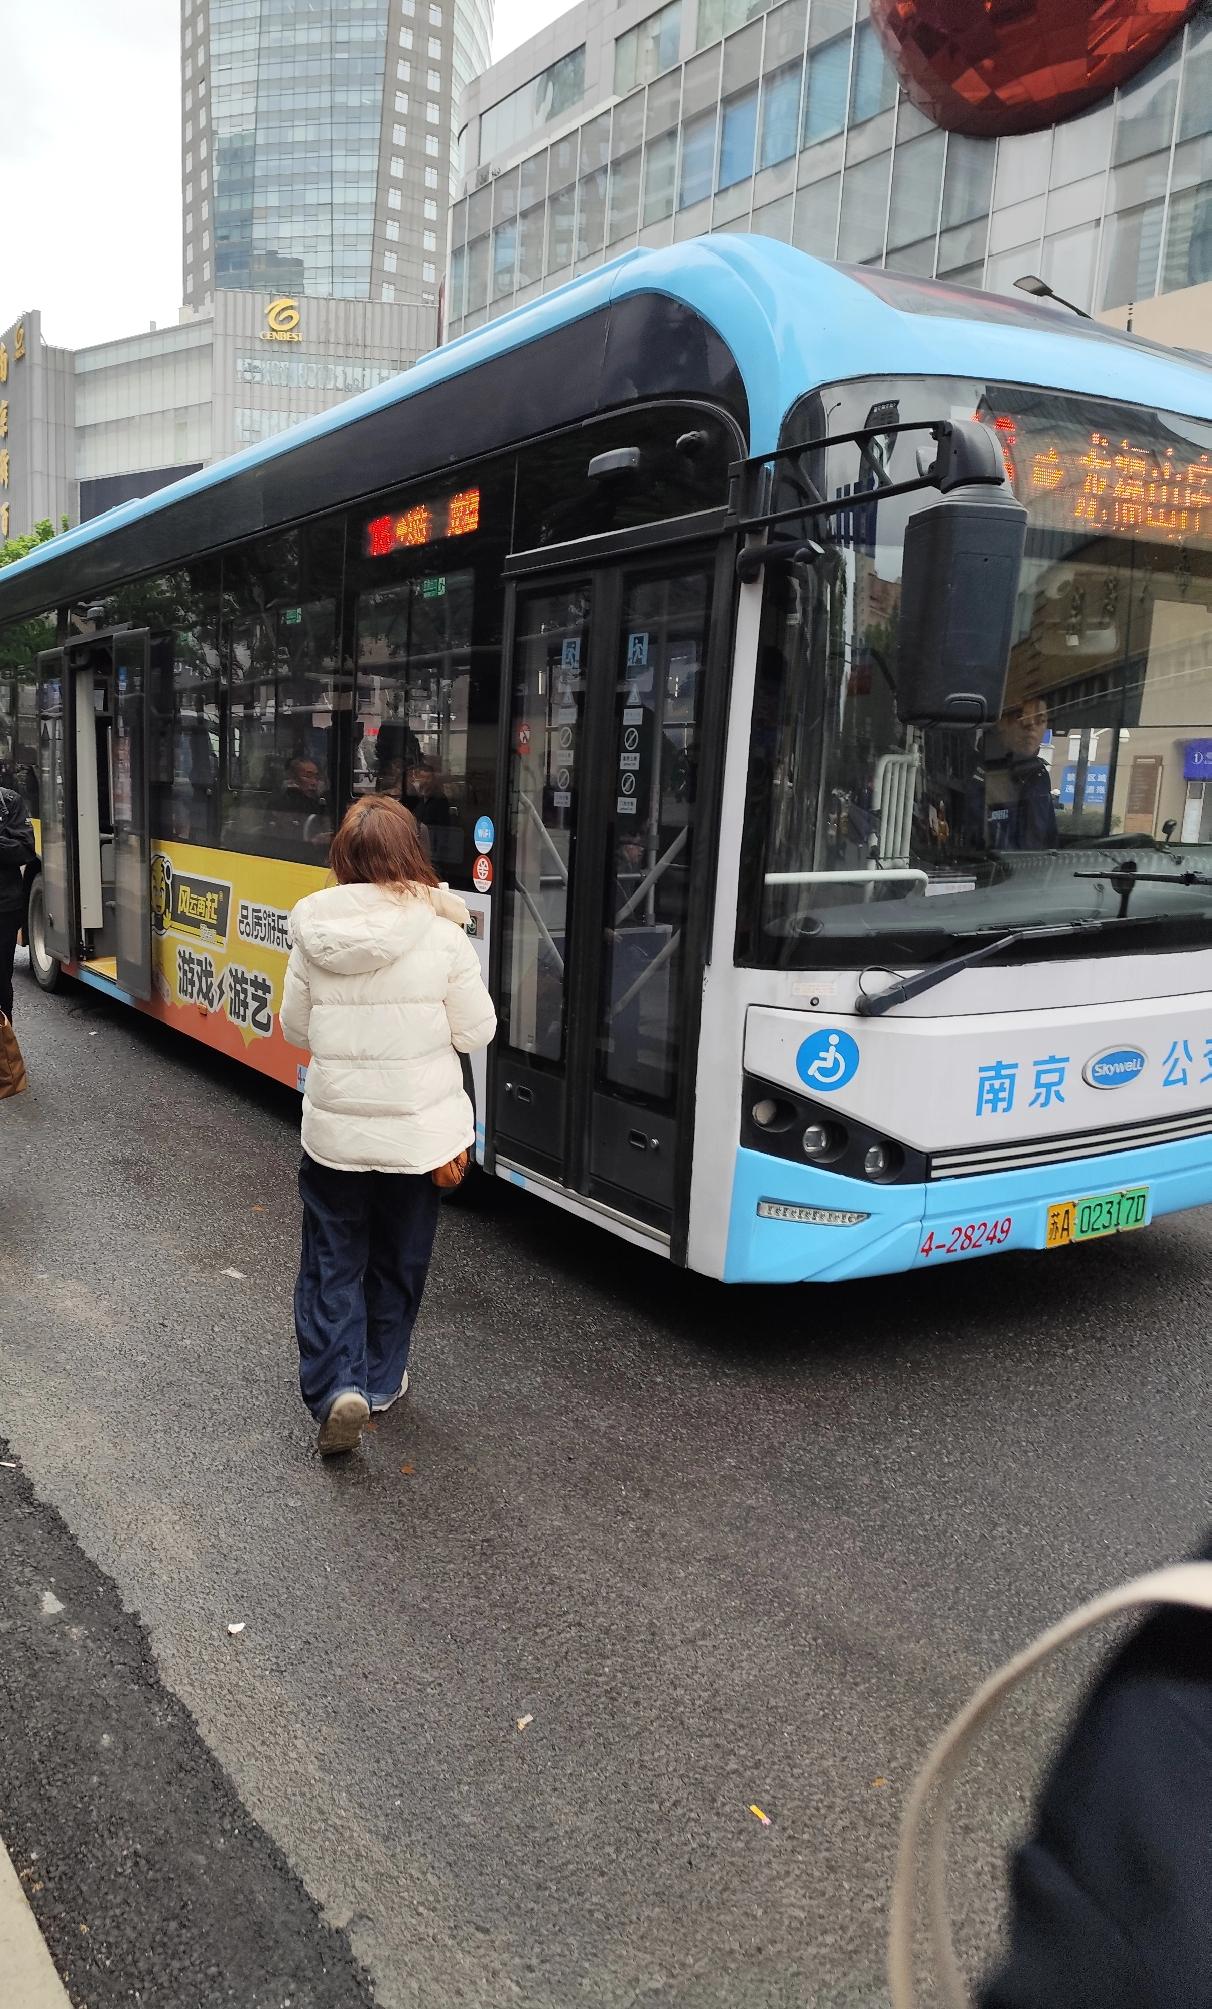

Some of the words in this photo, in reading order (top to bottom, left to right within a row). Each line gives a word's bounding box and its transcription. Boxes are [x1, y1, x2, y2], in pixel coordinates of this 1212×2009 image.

[259, 331, 303, 342] CENBEST
[177, 948, 214, 1009] 游戏
[228, 966, 272, 1033] 游艺
[975, 1054, 1070, 1117] 南京
[920, 1217, 1012, 1258] 4-28249
